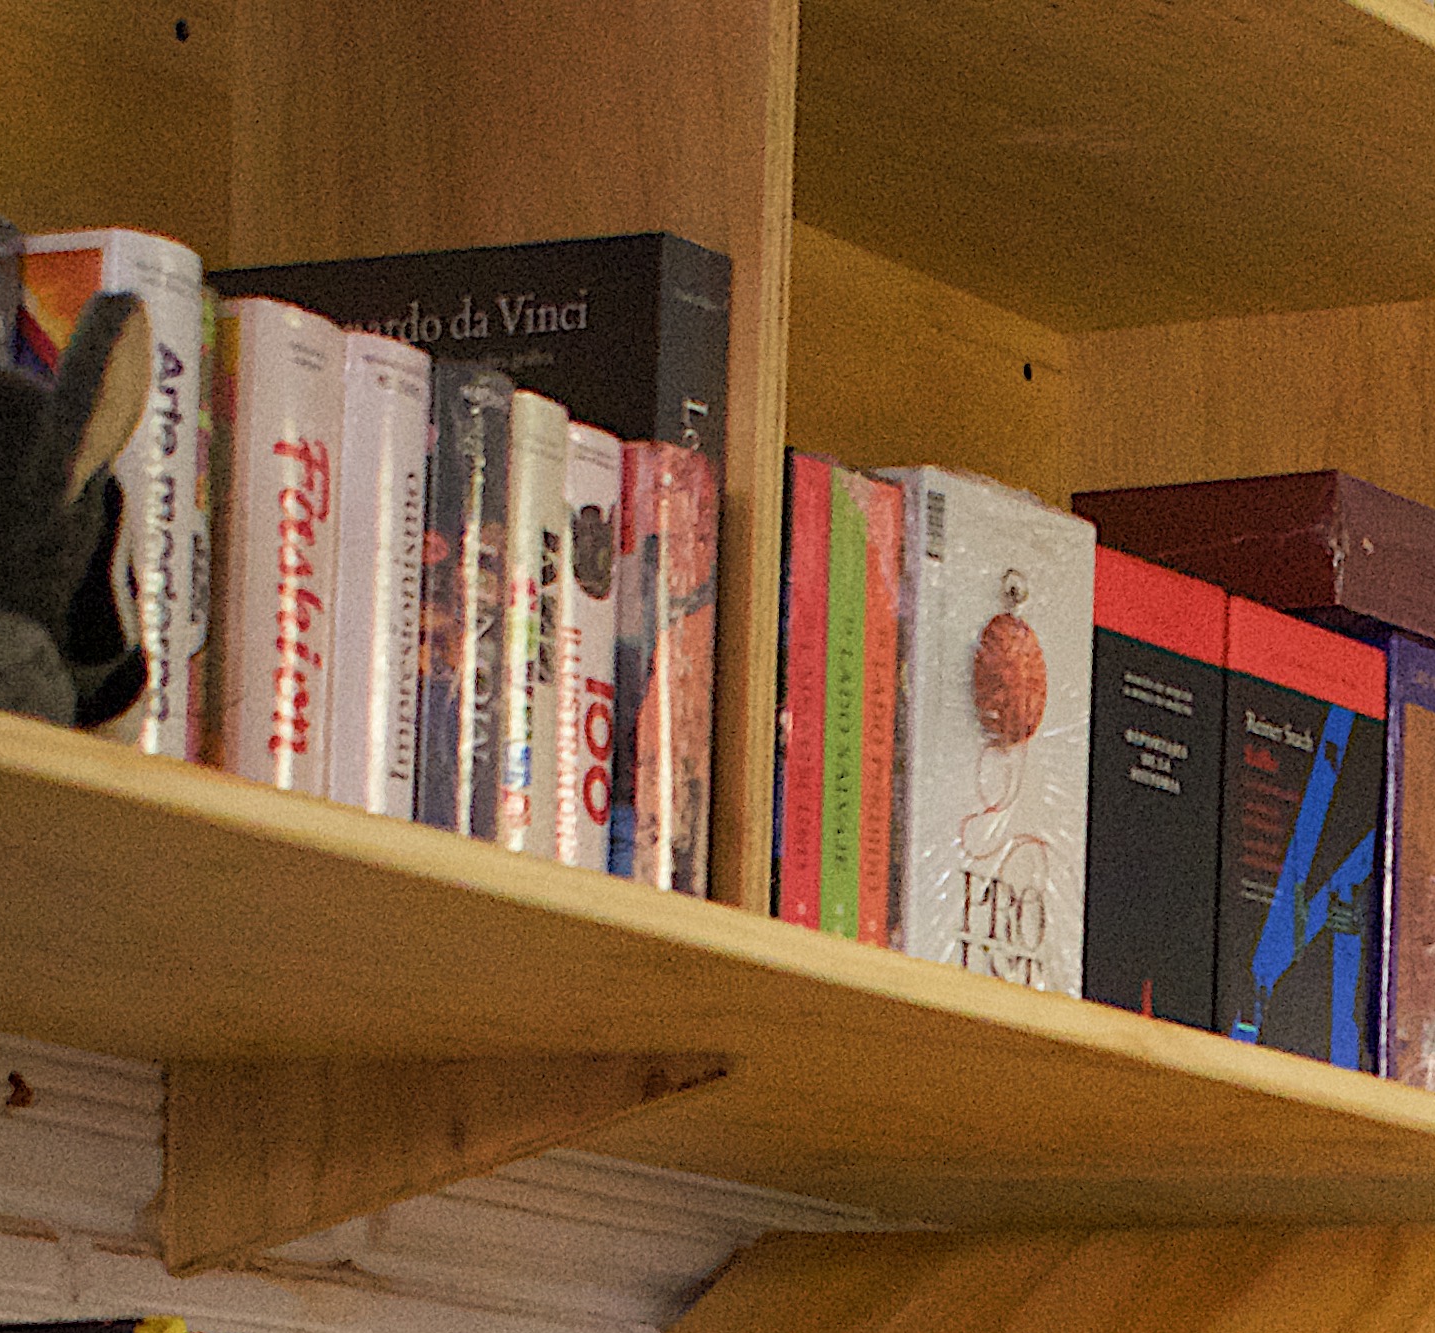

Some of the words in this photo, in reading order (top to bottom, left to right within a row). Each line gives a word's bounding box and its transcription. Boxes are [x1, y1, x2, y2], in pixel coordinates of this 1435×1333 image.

[449, 297, 497, 341] da
[498, 291, 589, 337] Vinci
[269, 435, 332, 755] Fashion
[582, 676, 616, 825] 100
[960, 868, 1047, 949] PRO
